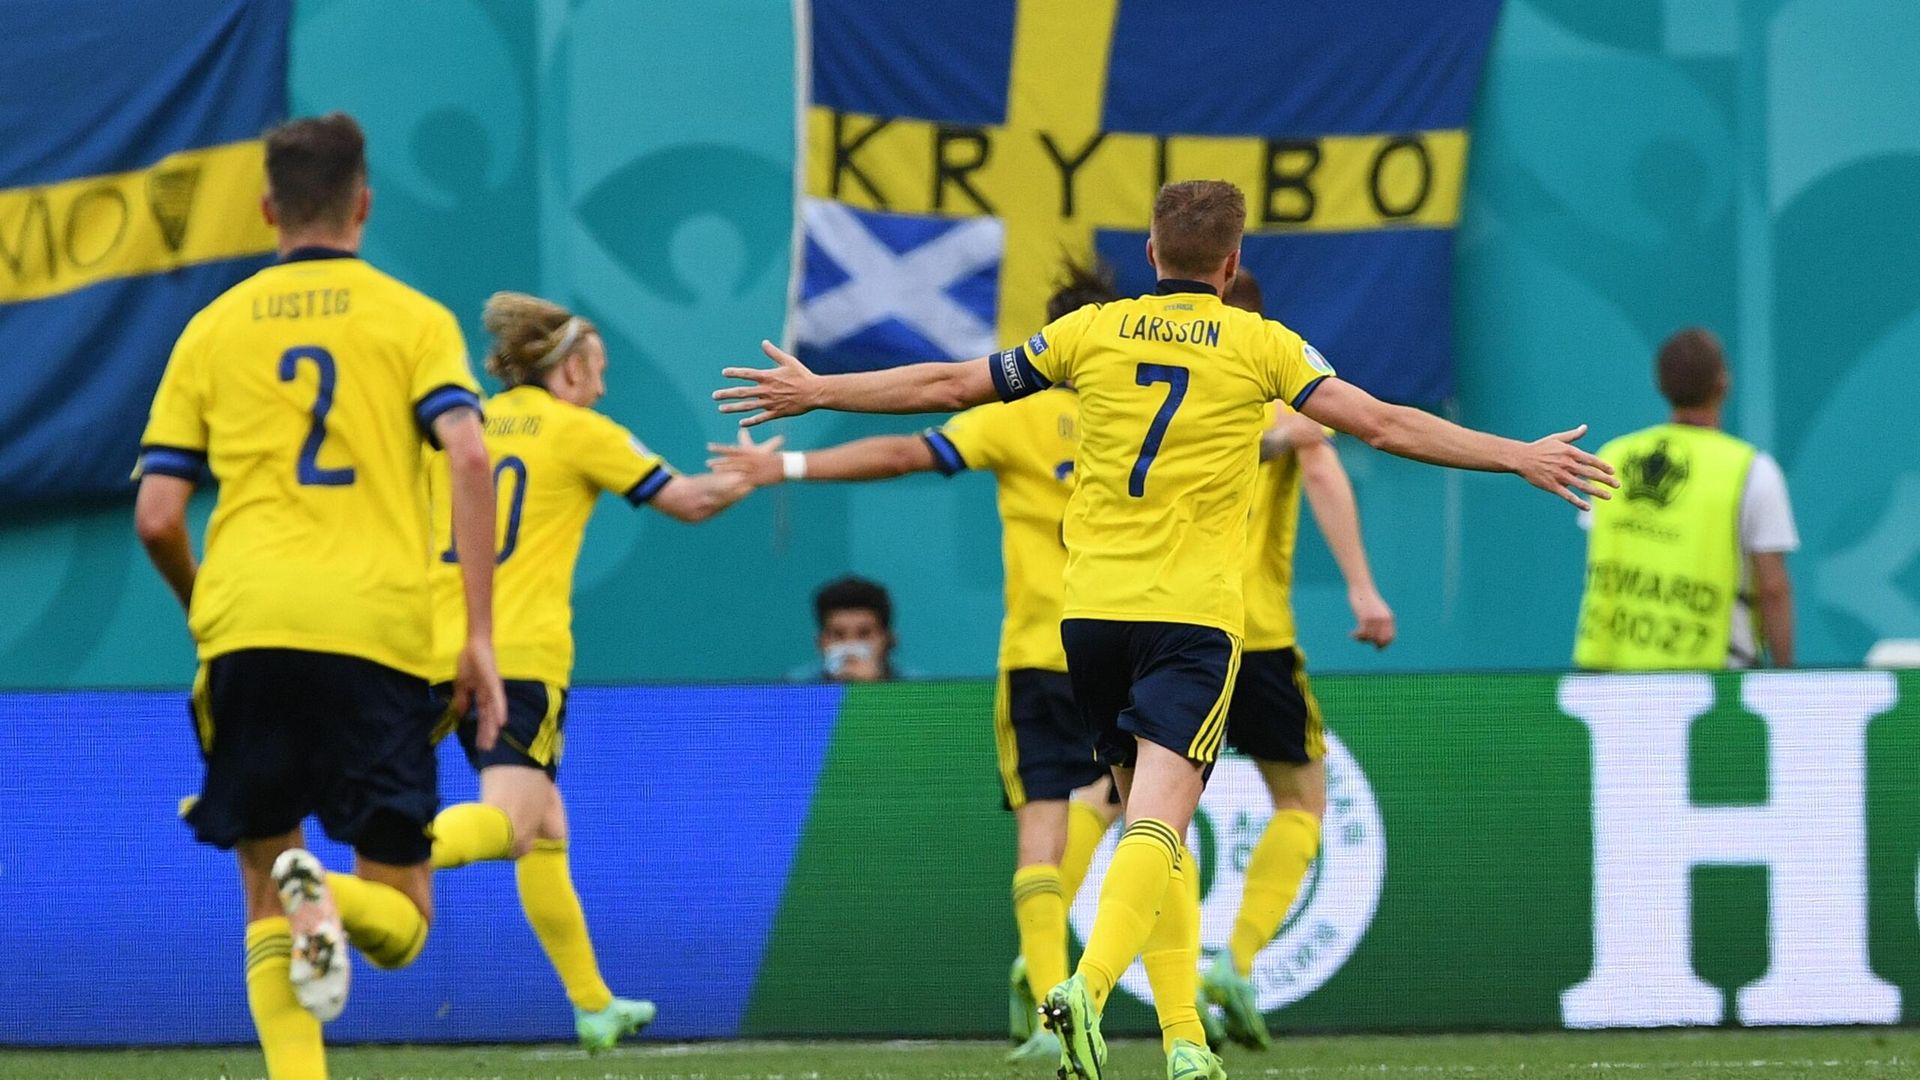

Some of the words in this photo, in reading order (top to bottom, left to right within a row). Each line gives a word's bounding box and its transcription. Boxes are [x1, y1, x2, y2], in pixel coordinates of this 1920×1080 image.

[251, 288, 352, 321] LUSTIG
[1118, 313, 1221, 348] LARSSON
[278, 345, 357, 486] 2
[1003, 350, 1023, 391] RESPECT
[1128, 362, 1190, 498] 7
[440, 455, 527, 566] 0
[1557, 672, 1920, 1028] H
